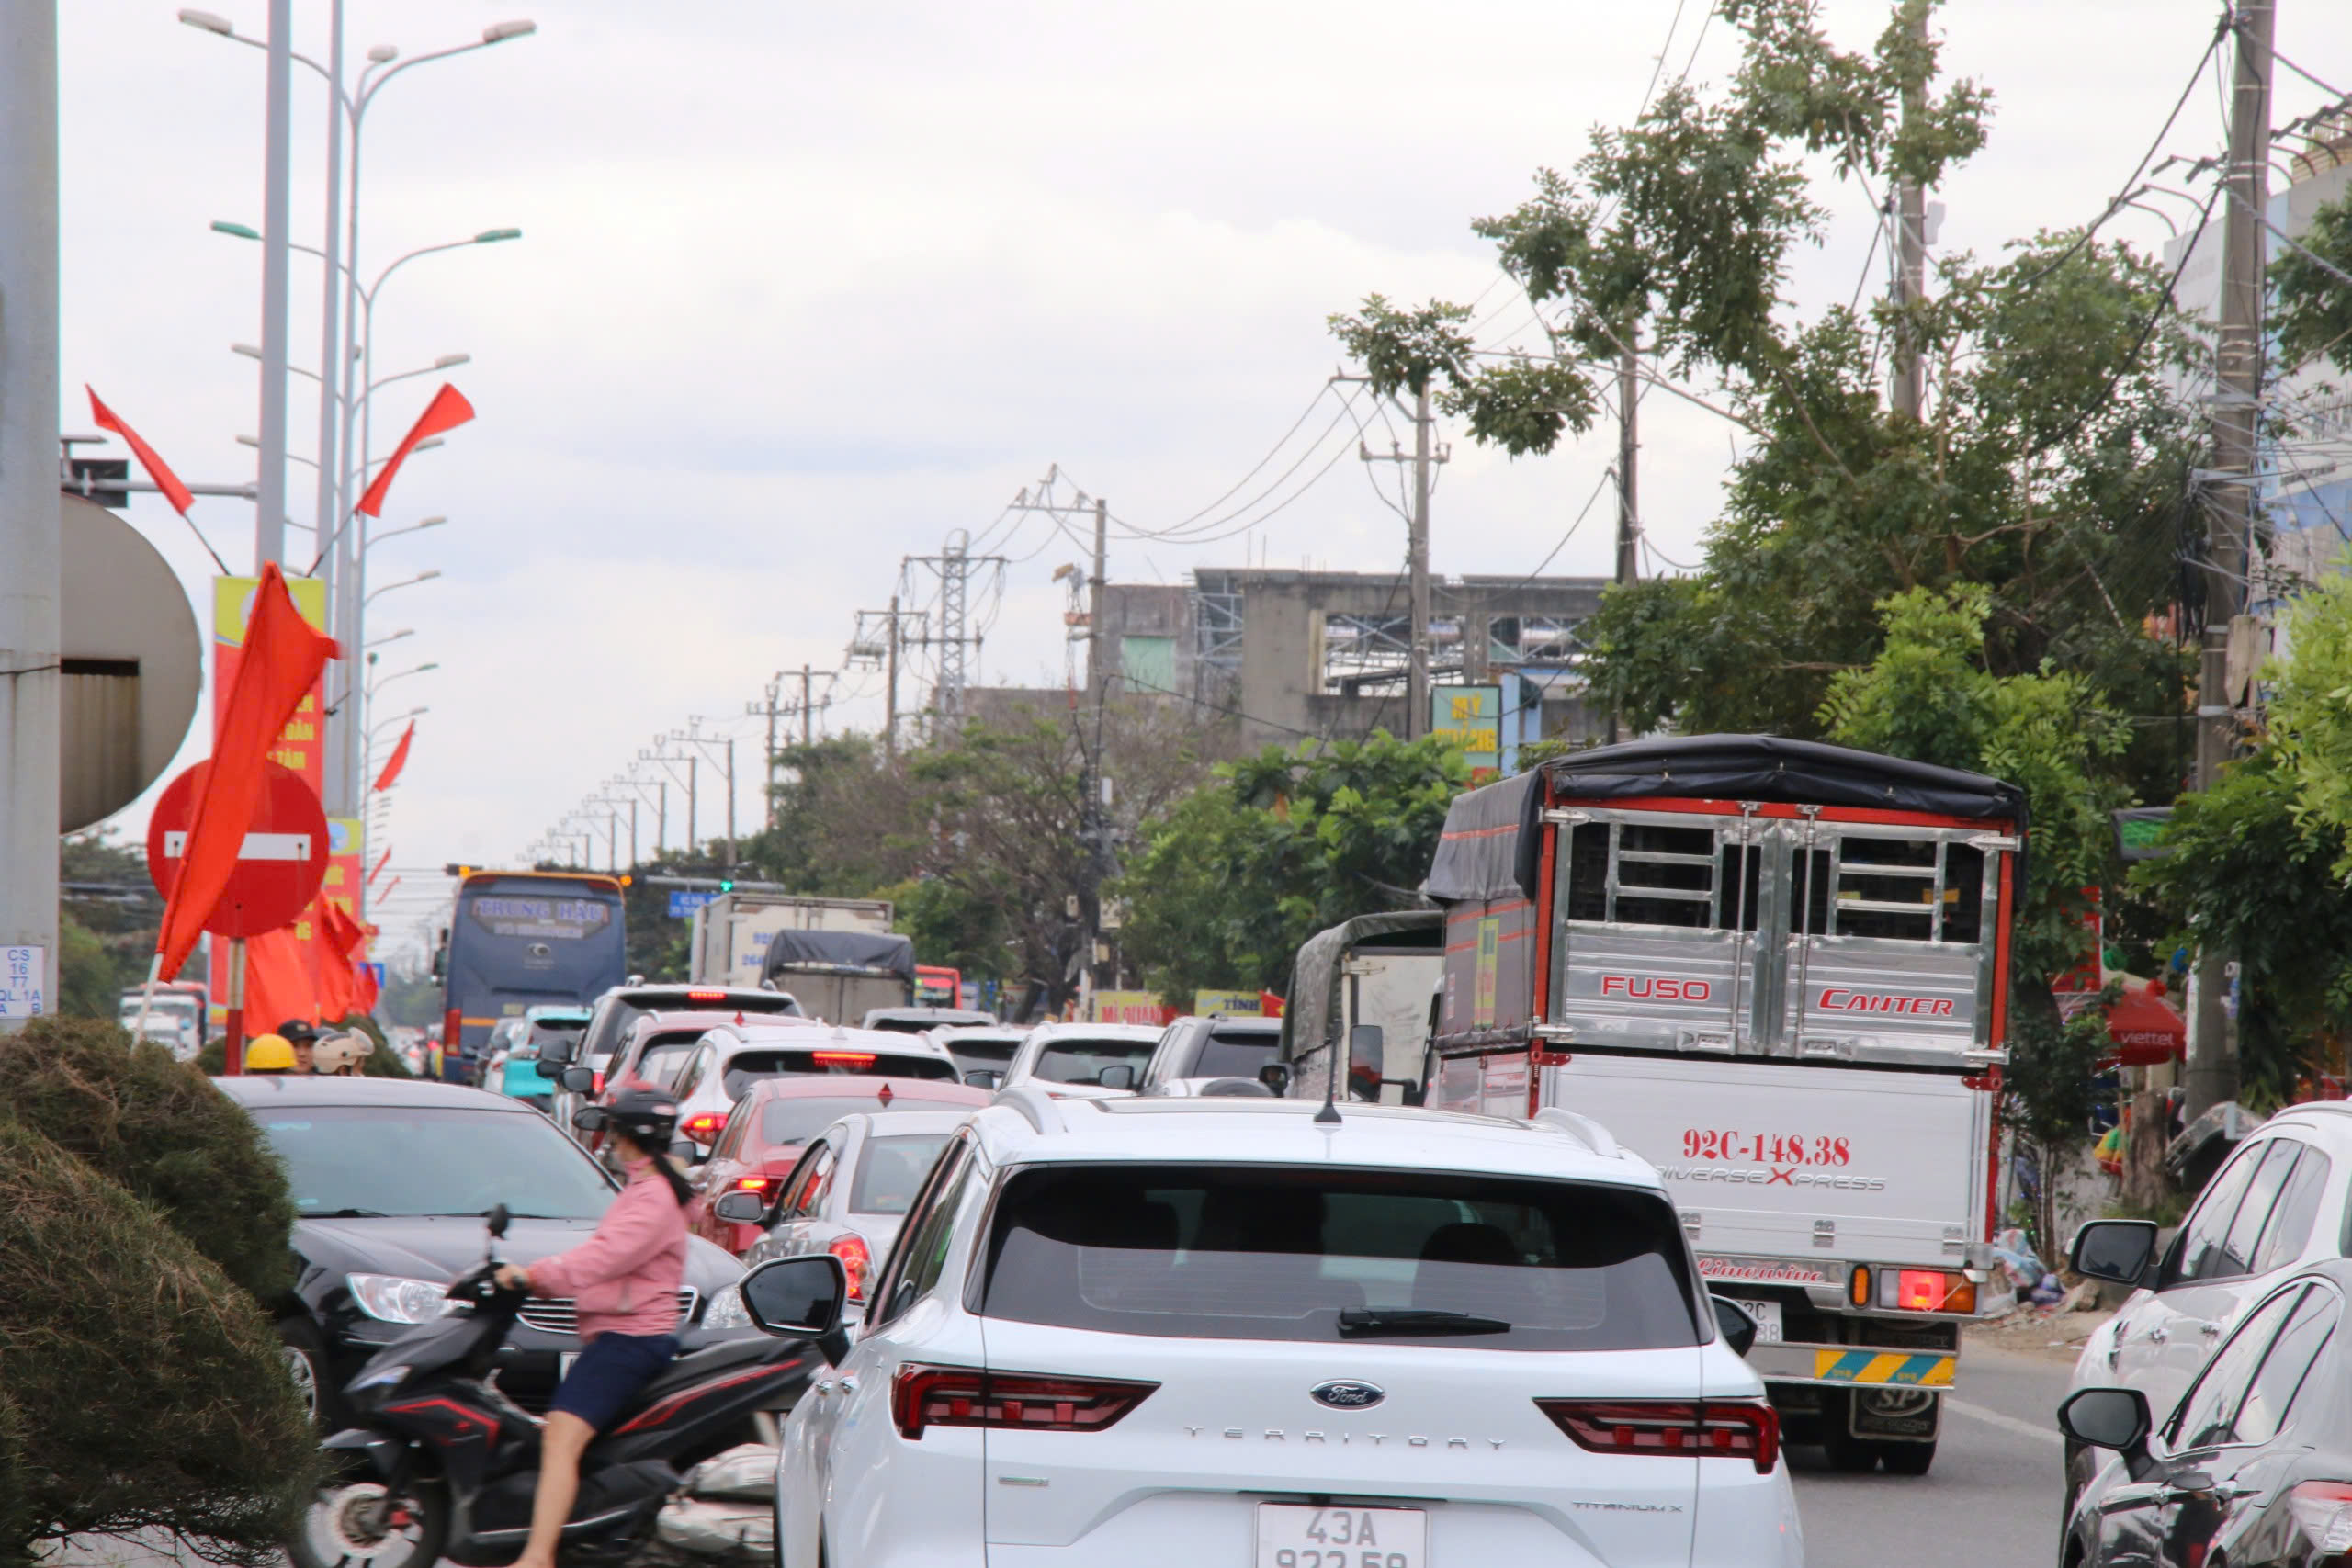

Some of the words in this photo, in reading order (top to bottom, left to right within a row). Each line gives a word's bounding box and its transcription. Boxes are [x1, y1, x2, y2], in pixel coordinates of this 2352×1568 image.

[480, 900, 550, 919] TRUNG
[7, 949, 30, 962] CS
[9, 963, 28, 975] 16
[8, 976, 28, 987] T7
[1602, 976, 1711, 1001] FUSO
[32, 1003, 41, 1014] B
[2120, 1032, 2175, 1046] viettel
[1682, 1128, 1850, 1167] 92C-148.38
[1698, 1258, 1825, 1283] Limousine
[1739, 1301, 1766, 1321] 2C
[1327, 1385, 1369, 1404] Ford
[1183, 1426, 1507, 1450] TERRITORY
[1572, 1500, 1666, 1513] TITANIUM
[1668, 1505, 1684, 1513] X
[1306, 1511, 1377, 1546] 43A
